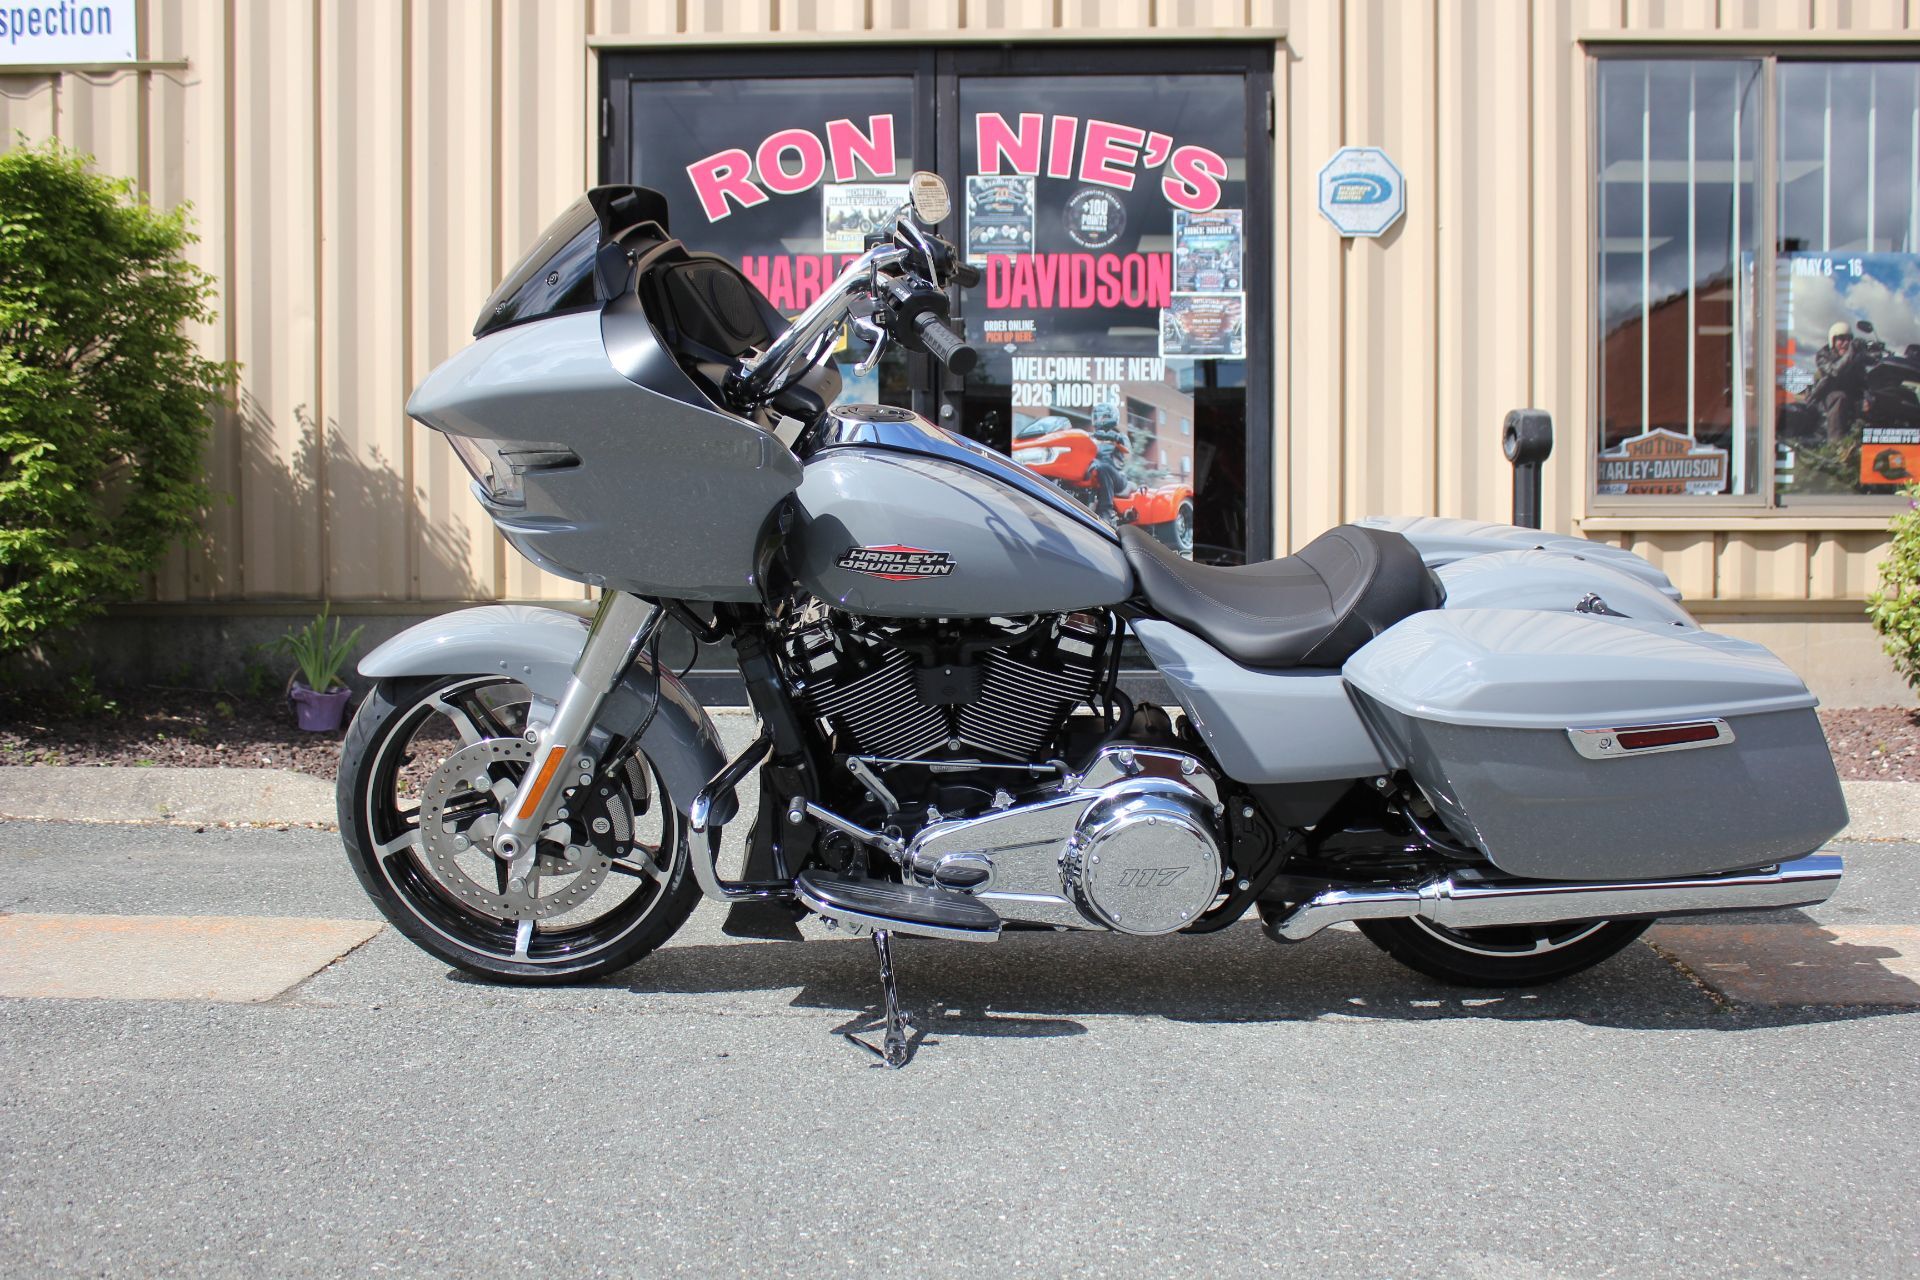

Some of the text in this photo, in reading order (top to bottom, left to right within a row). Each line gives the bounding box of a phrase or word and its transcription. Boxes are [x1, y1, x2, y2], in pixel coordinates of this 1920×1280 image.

[686, 112, 1228, 223] RON NIE'S
[1082, 199, 1108, 215] +100
[1081, 214, 1107, 226] POINTS
[1796, 258, 1821, 277] MAY
[1823, 258, 1832, 277] 8
[1848, 258, 1863, 277] 16
[986, 253, 1172, 309] DAVIDSON
[984, 320, 1036, 331] ORDER ONLINE.
[986, 331, 1003, 343] PICK
[1004, 331, 1013, 343] UP
[1011, 357, 1165, 382] WELCOME THE NEW
[1011, 383, 1125, 408] 2026 MODELS.
[1633, 437, 1685, 456] MOTOR
[1598, 459, 1719, 480] HARLEY-DAVIDSON
[850, 550, 945, 564] HARLEY-
[839, 559, 951, 575] DAVIDSON
[1118, 866, 1190, 887] 117
